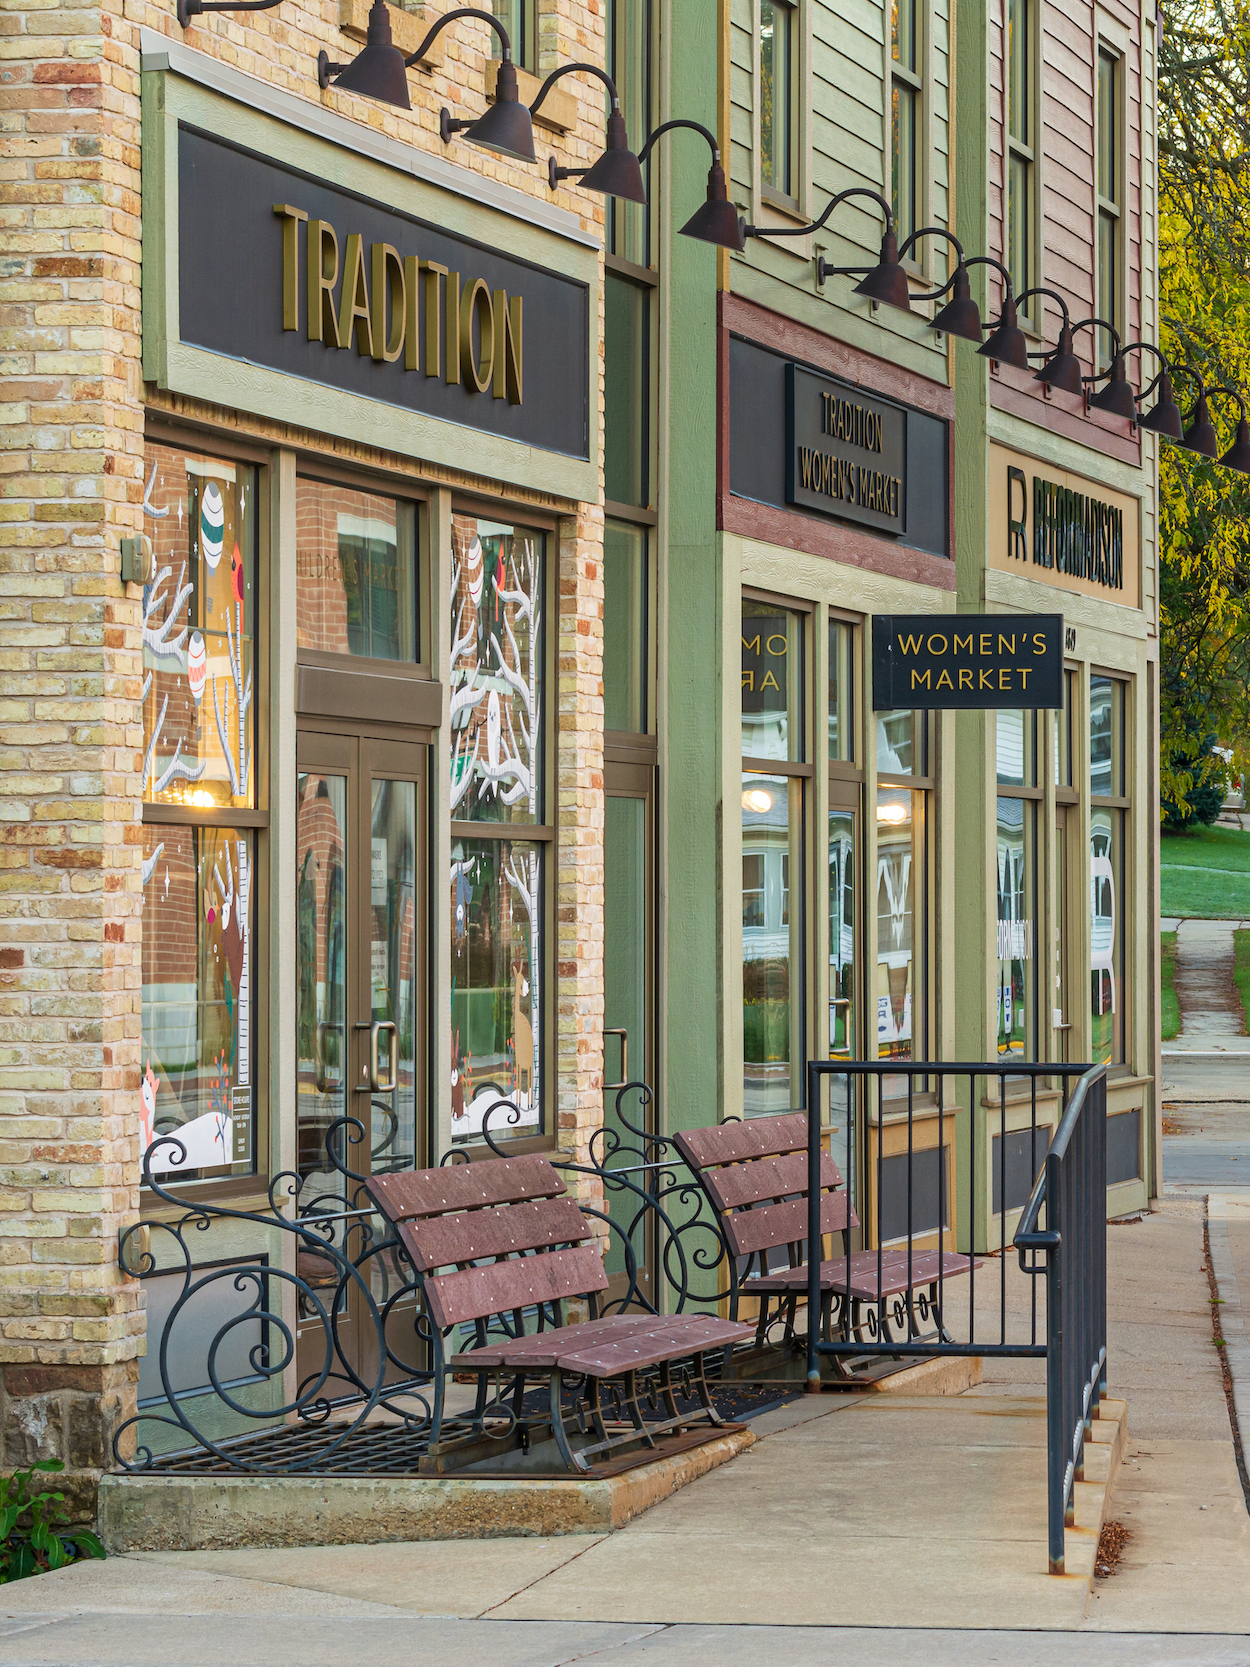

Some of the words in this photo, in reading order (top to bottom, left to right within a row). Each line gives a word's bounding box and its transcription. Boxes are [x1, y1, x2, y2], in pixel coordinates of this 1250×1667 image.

[273, 204, 523, 406] TRADITION
[821, 391, 884, 454] TRADITION
[799, 445, 856, 503] WOMEN'S
[858, 465, 902, 518] MARKET
[1033, 476, 1123, 590] REFORMADISON
[897, 633, 1048, 656] WOMEN'S
[911, 668, 1033, 690] MARKET
